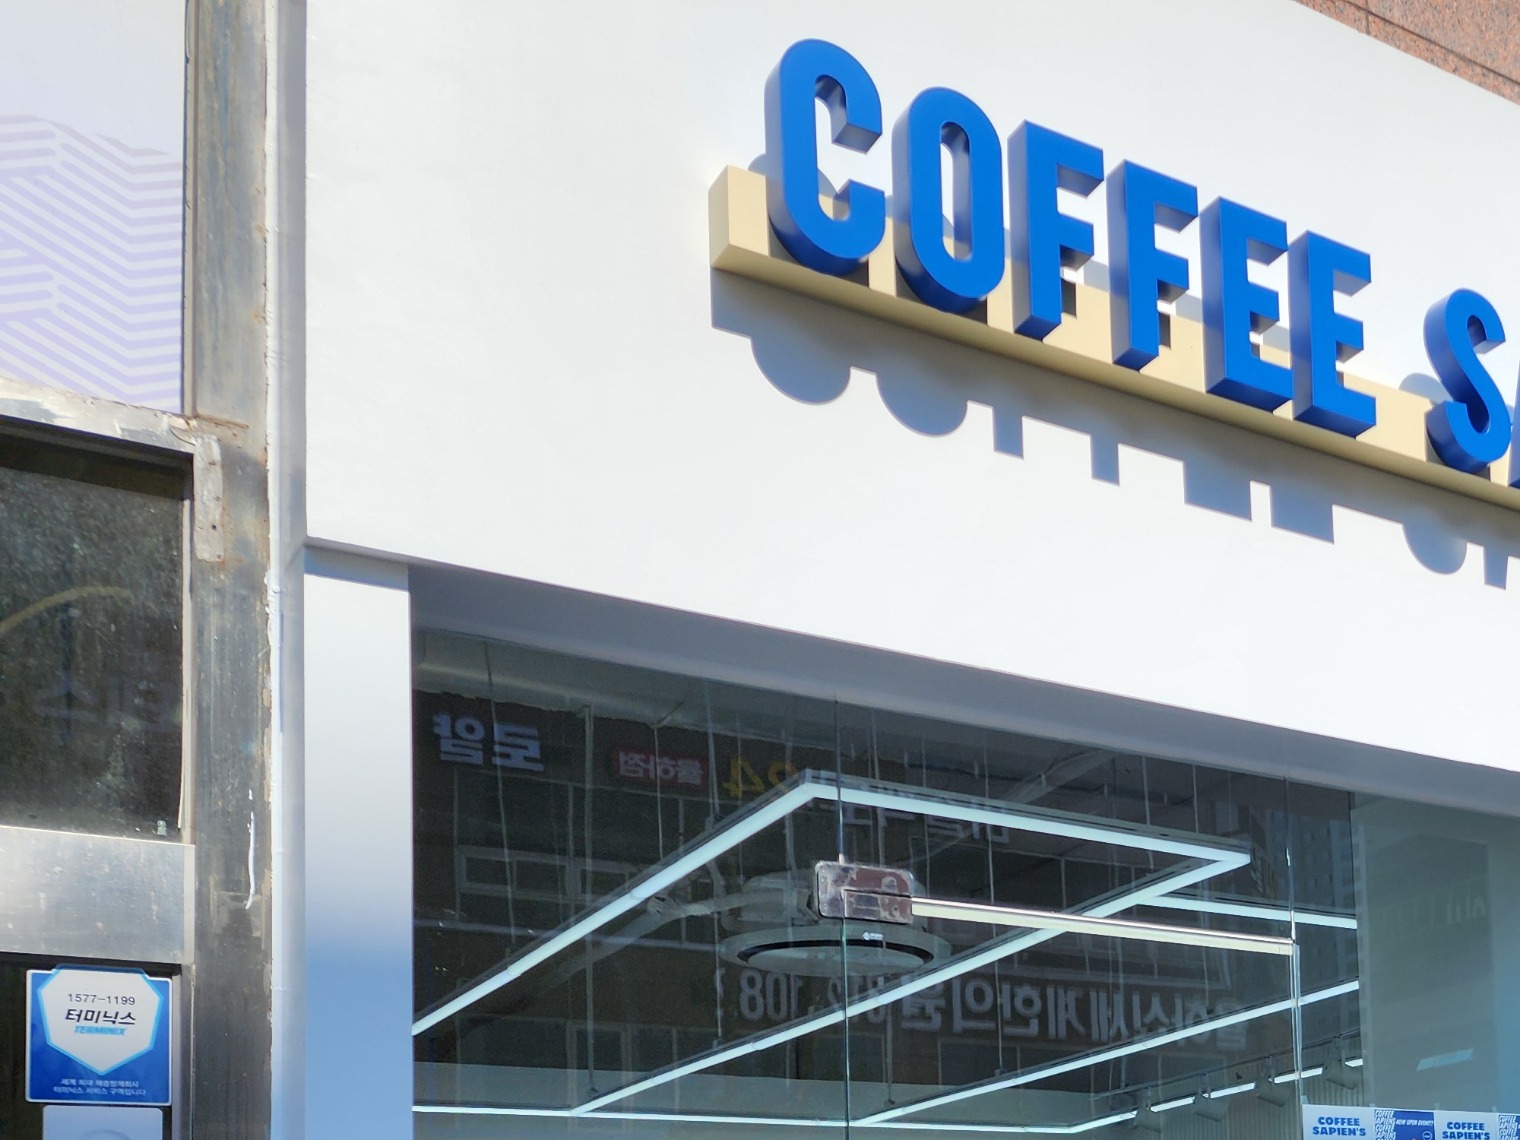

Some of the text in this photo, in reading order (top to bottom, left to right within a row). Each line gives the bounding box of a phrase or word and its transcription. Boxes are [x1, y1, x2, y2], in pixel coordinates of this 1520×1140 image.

[765, 39, 1376, 436] COFFEE
[68, 993, 136, 1006] 1577-1199
[65, 1008, 137, 1026] 터미닉스
[1318, 1117, 1361, 1127] COFFEE
[1446, 1121, 1485, 1132] COFFEE
[1312, 1126, 1367, 1137] SAPIEN'S
[1442, 1130, 1491, 1140] SAPIEN'S
